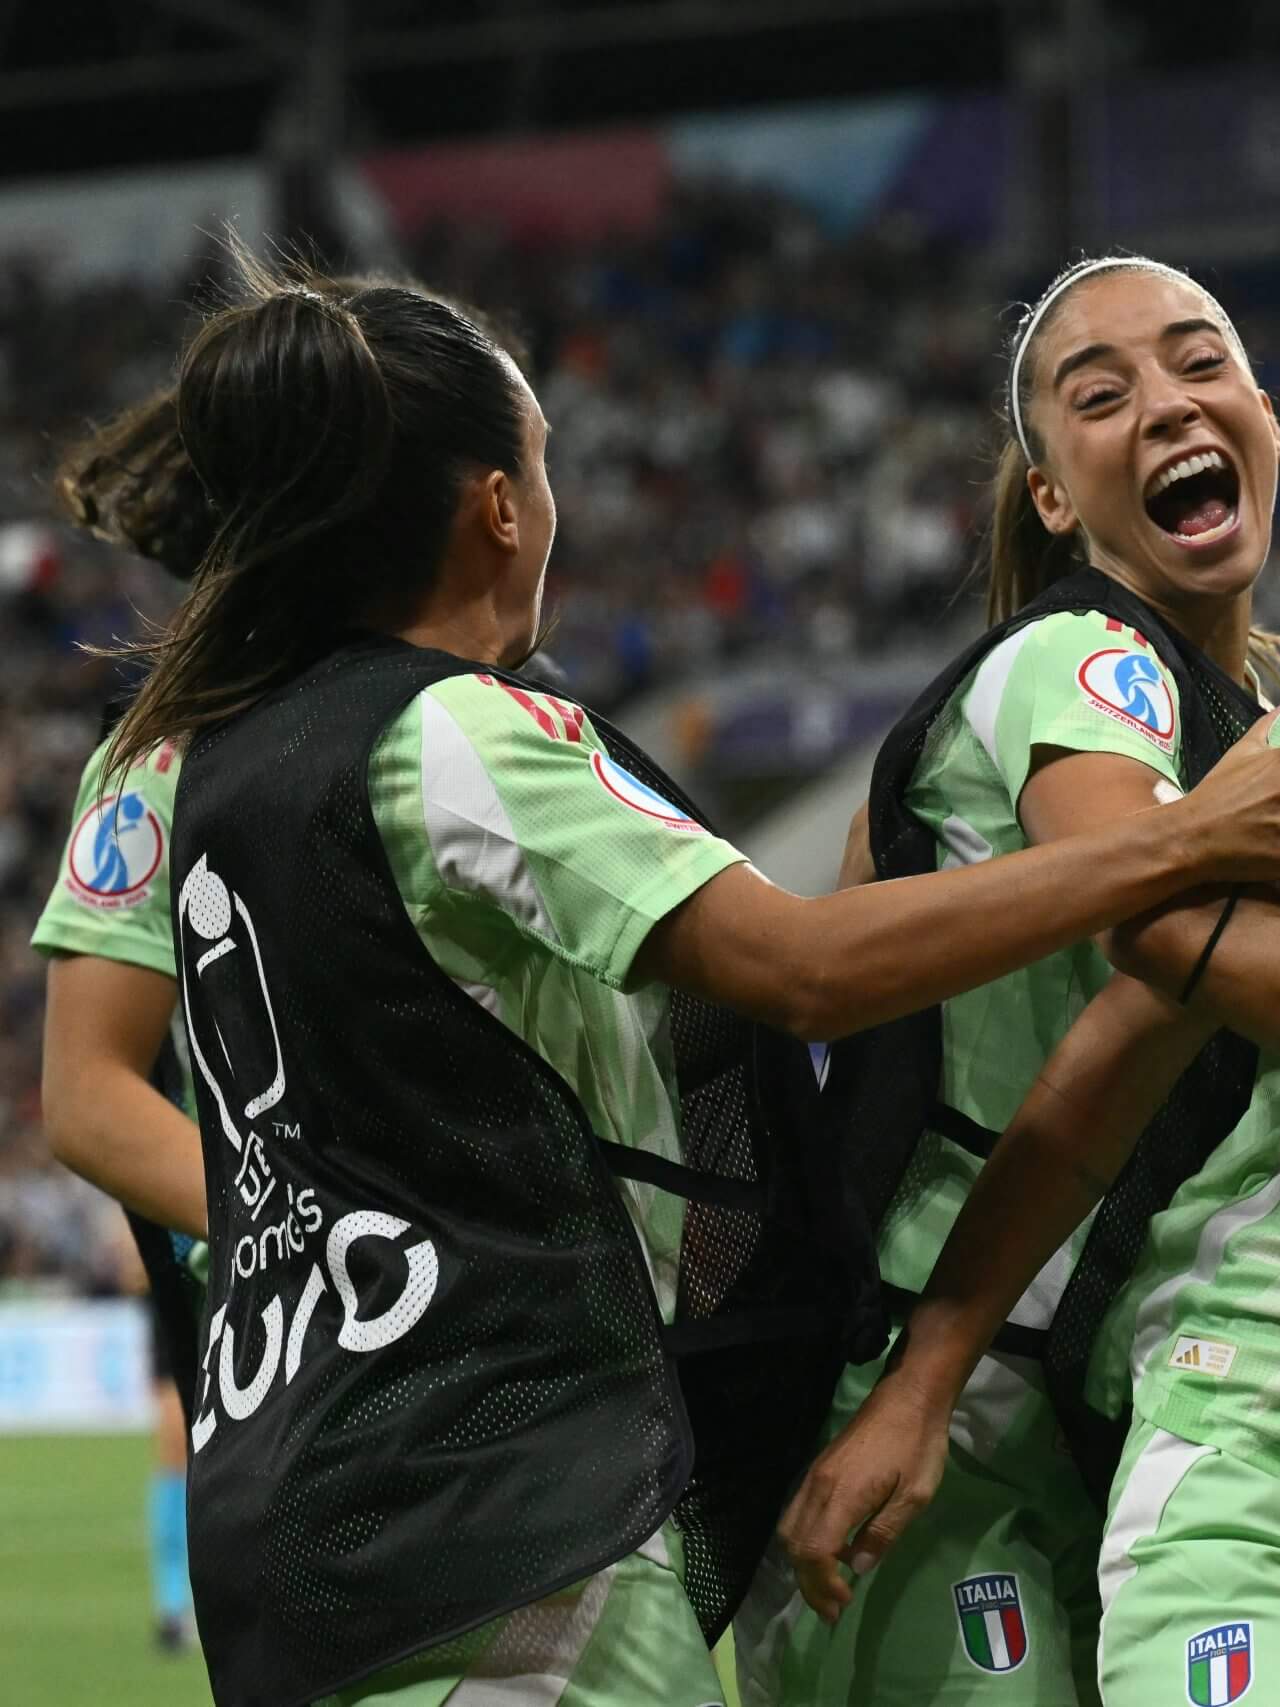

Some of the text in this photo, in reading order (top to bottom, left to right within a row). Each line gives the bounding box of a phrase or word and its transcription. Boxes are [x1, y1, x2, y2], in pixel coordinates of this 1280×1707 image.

[1087, 699, 1157, 743] SWITZERLAND
[957, 1580, 1016, 1606] ITALIA
[1190, 1627, 1248, 1657] ITALIA
